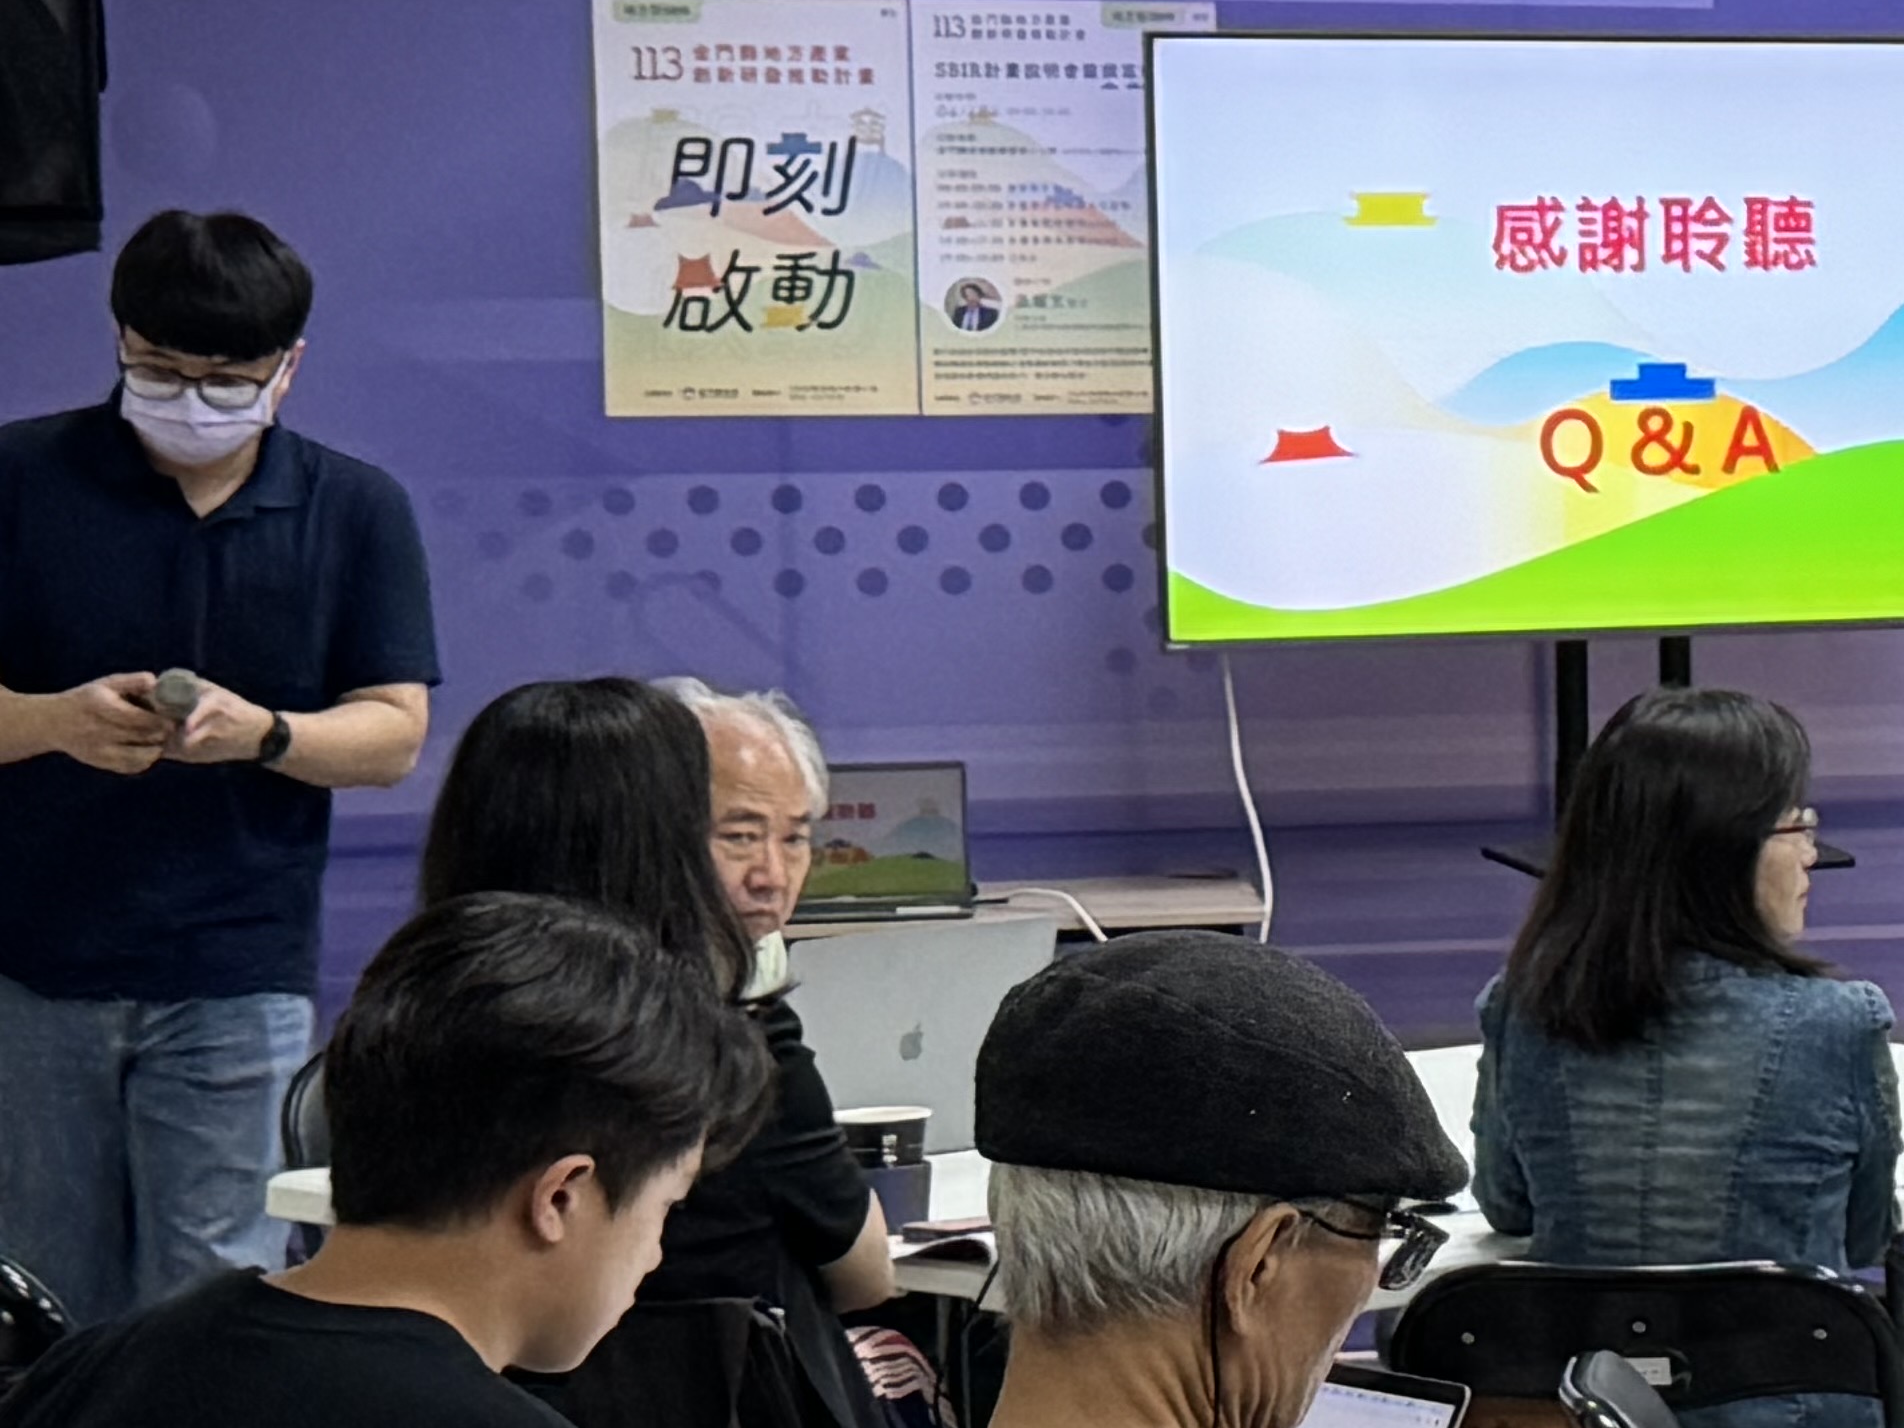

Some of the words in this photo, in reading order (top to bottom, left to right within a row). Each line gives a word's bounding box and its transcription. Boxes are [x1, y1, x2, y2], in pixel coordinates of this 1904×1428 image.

[631, 46, 684, 80] 113
[673, 135, 857, 218] 即刻
[1493, 195, 1817, 273] 感謝聆聽
[1540, 408, 1600, 493] Q
[1630, 406, 1702, 477] &
[1724, 405, 1782, 474] A
